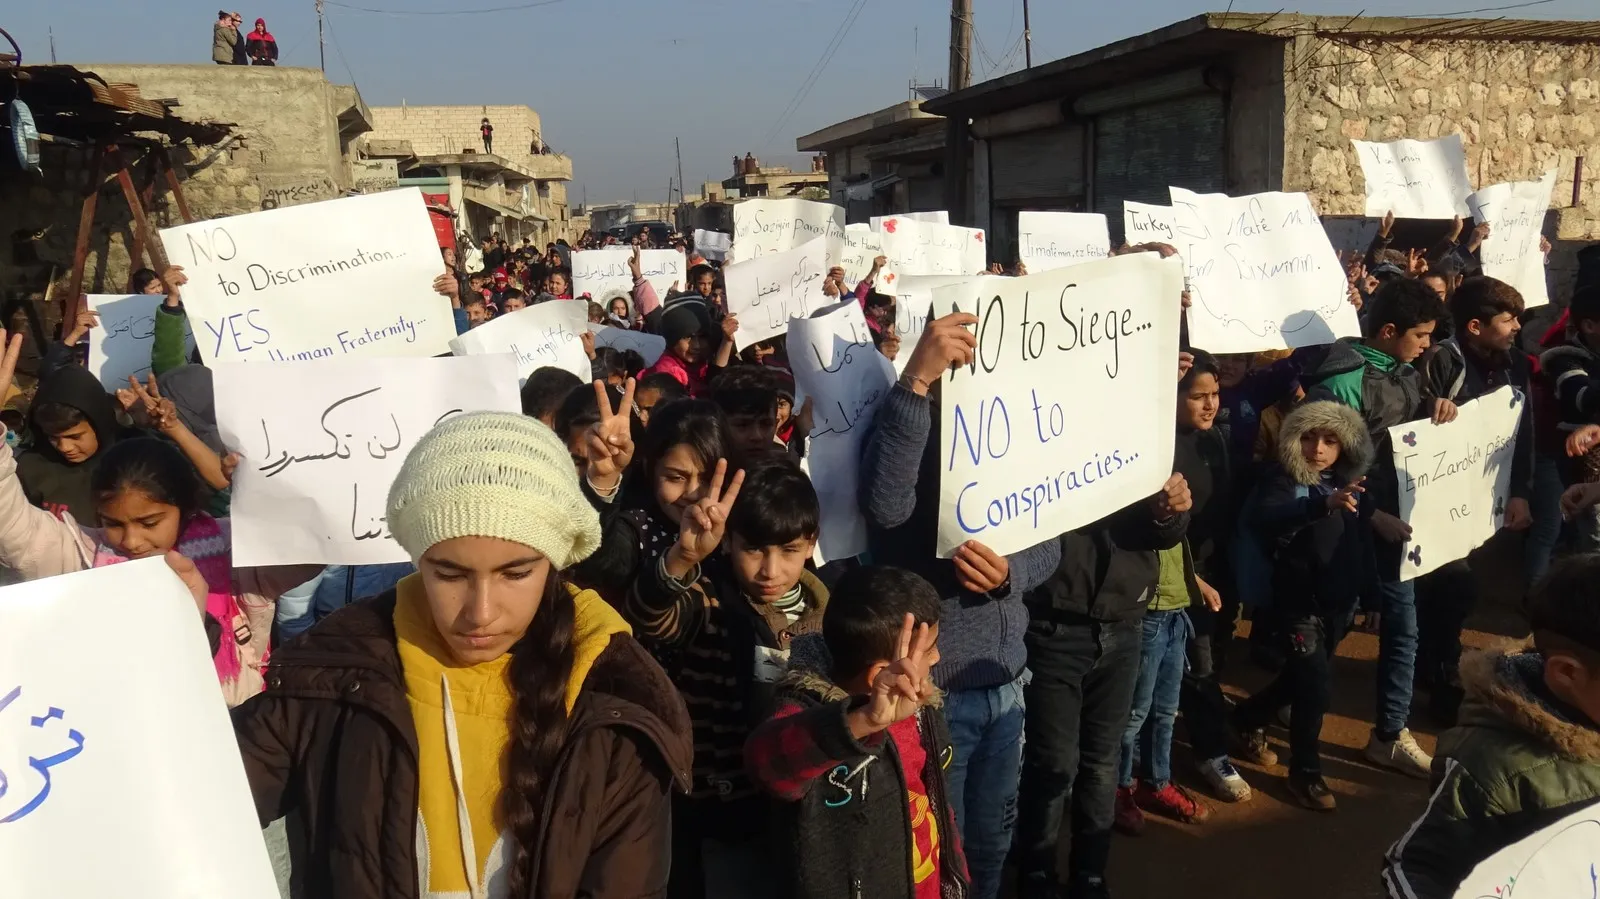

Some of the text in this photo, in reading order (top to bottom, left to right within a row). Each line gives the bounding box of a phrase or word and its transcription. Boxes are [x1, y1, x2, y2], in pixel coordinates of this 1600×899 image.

[1127, 209, 1174, 241] Turkey
[186, 226, 238, 267] NO
[217, 272, 241, 297] to
[766, 287, 809, 329] أطالنا
[204, 309, 272, 358] YES
[337, 315, 428, 355] Fraternity...
[556, 323, 574, 345] to
[1020, 291, 1046, 362] to
[1057, 283, 1153, 380] Siege...
[366, 412, 402, 460] لن
[948, 388, 1065, 472] NO to
[955, 449, 1140, 534] Conspiracies...
[1404, 452, 1430, 493] Em
[1449, 503, 1471, 522] ne
